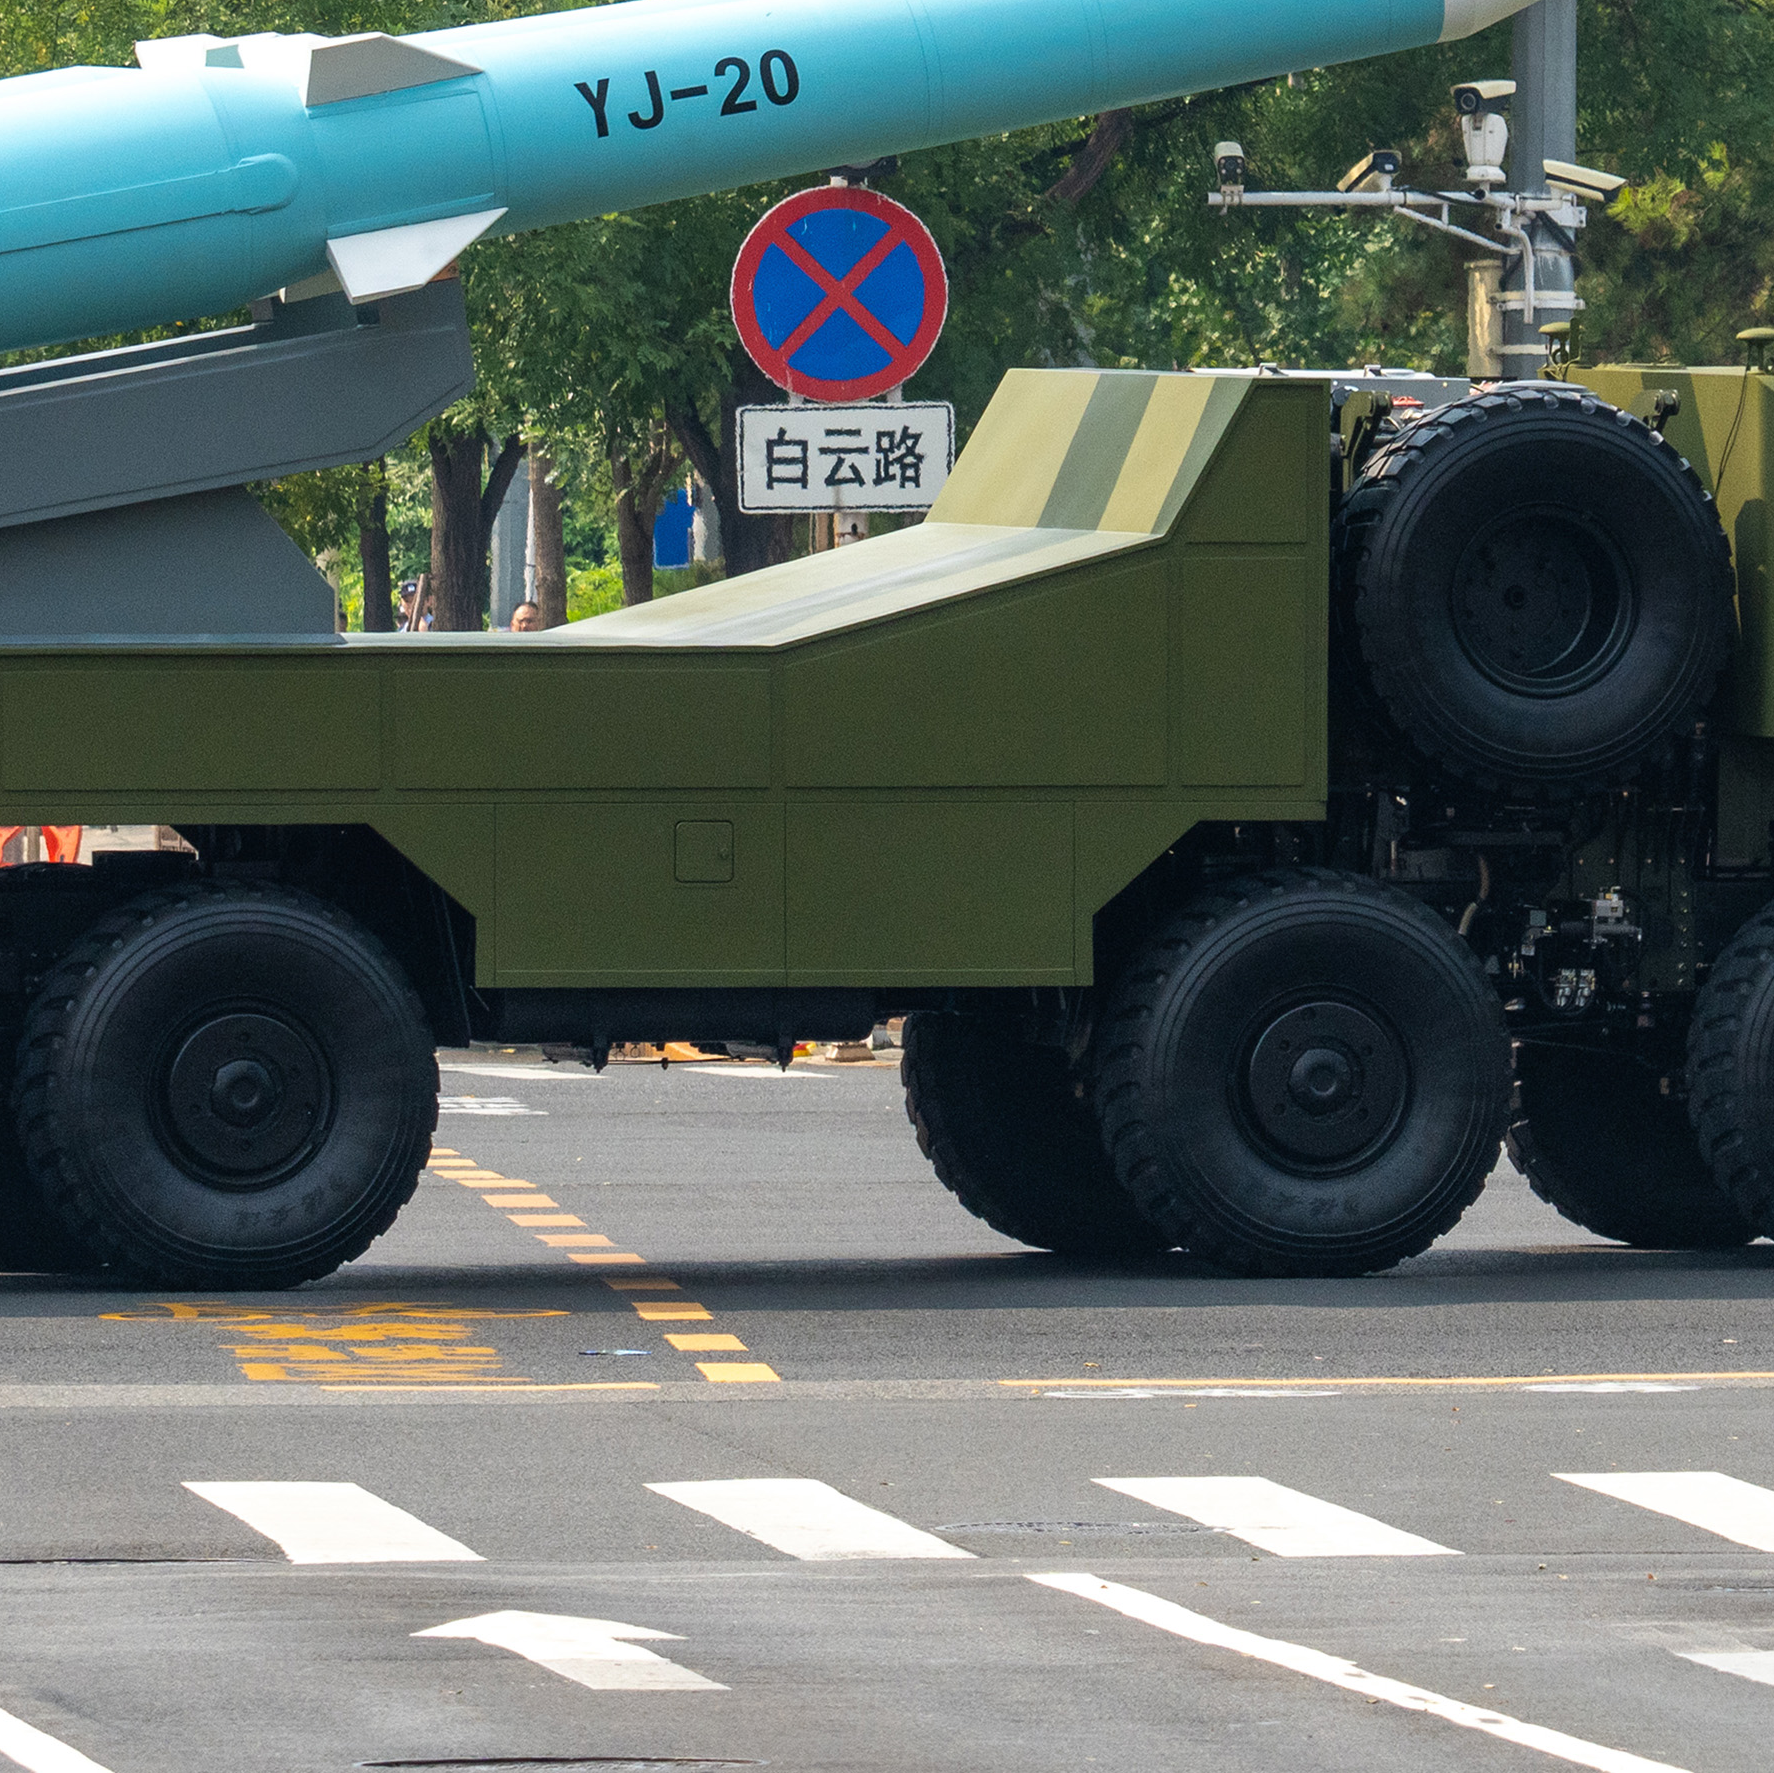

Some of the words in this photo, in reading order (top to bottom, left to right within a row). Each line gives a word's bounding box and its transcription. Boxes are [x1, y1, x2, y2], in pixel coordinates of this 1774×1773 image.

[574, 49, 800, 138] YJ-20
[765, 425, 925, 490] 白云路
